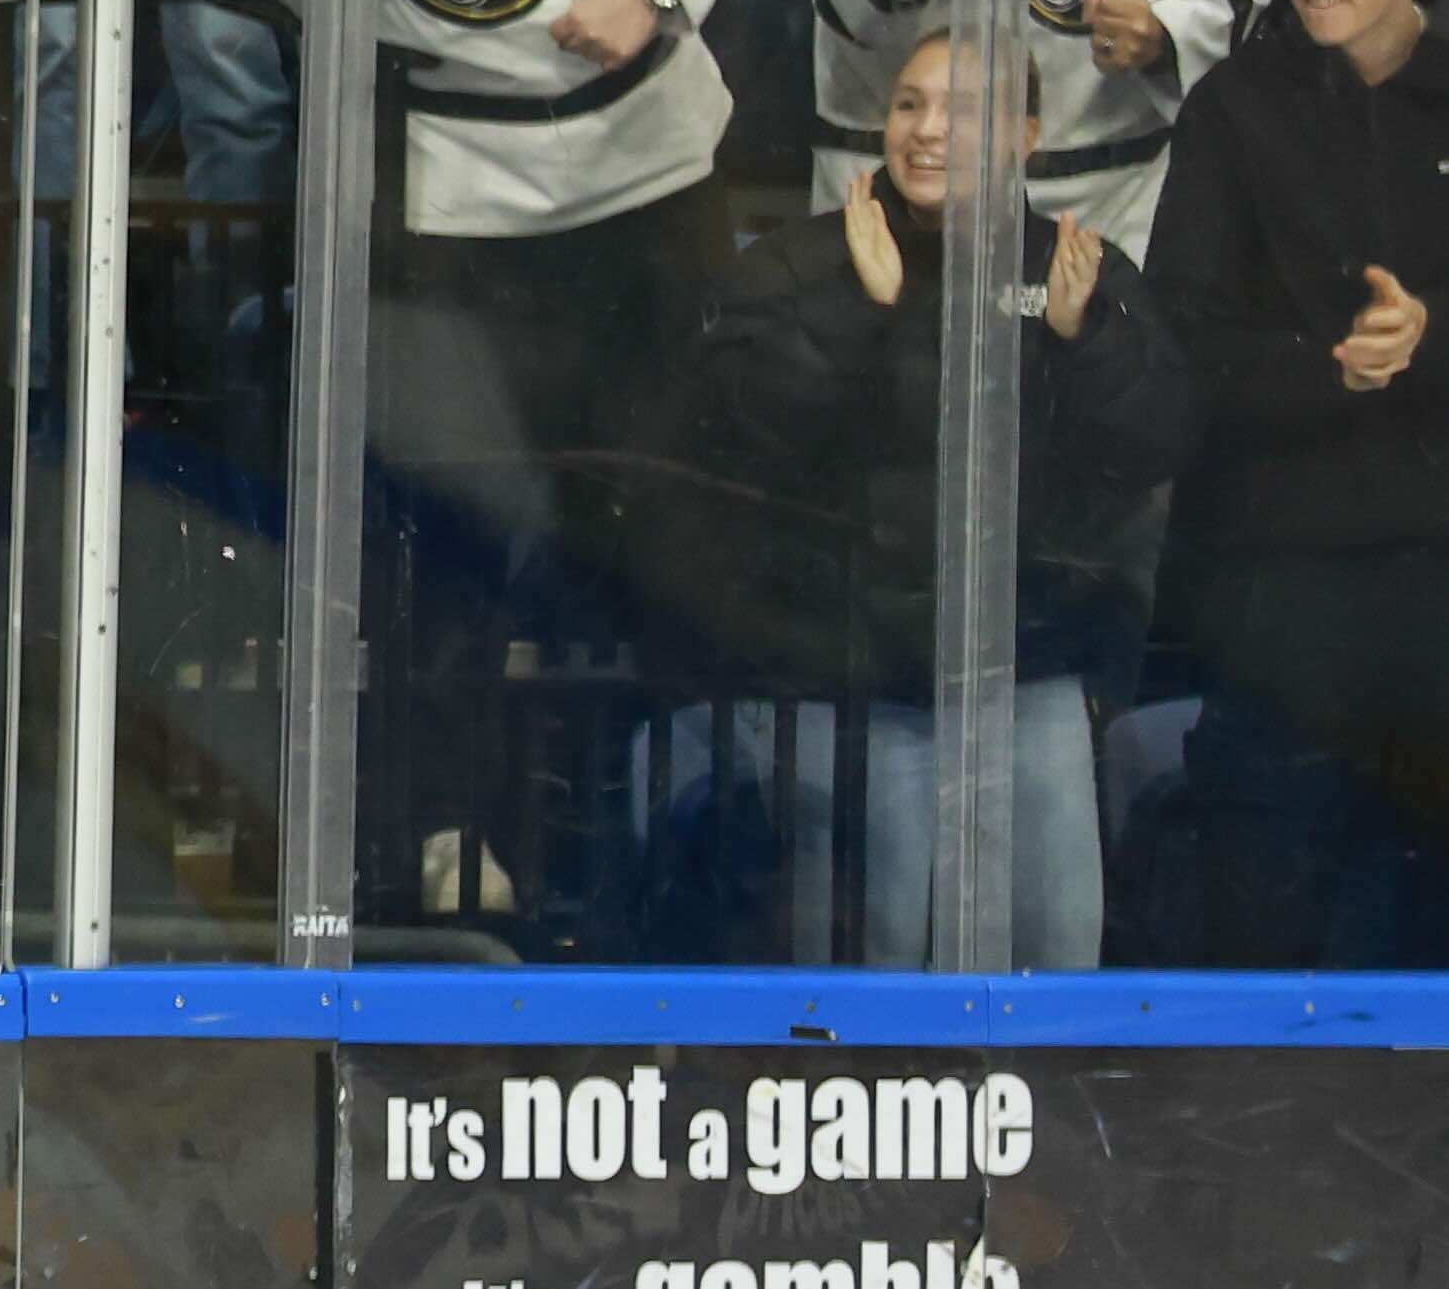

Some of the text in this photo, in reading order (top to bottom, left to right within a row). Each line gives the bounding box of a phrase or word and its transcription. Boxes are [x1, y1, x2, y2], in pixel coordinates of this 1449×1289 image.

[386, 1064, 1034, 1194] It's not a game
